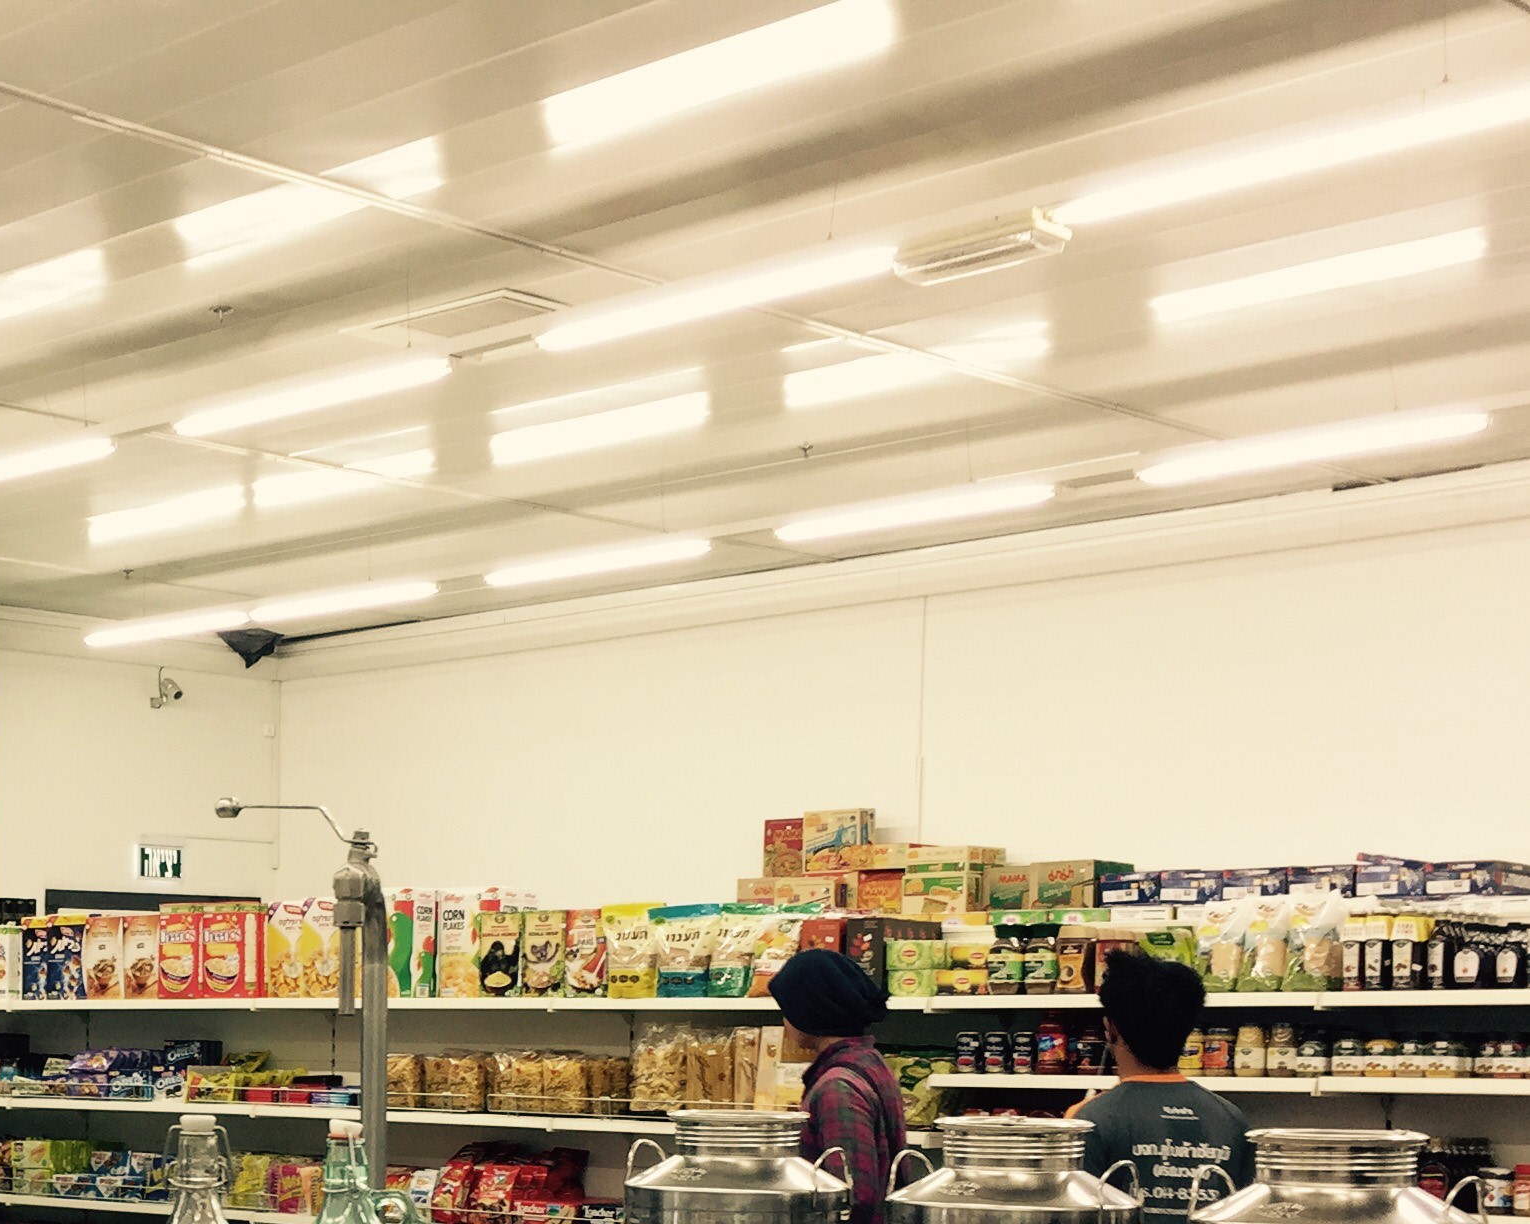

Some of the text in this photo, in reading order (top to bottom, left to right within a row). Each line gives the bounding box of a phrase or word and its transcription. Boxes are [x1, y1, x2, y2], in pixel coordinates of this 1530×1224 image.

[145, 848, 178, 878] יציאה
[416, 906, 433, 915] CORN
[442, 909, 465, 921] CORN
[442, 922, 465, 931] FLAKES
